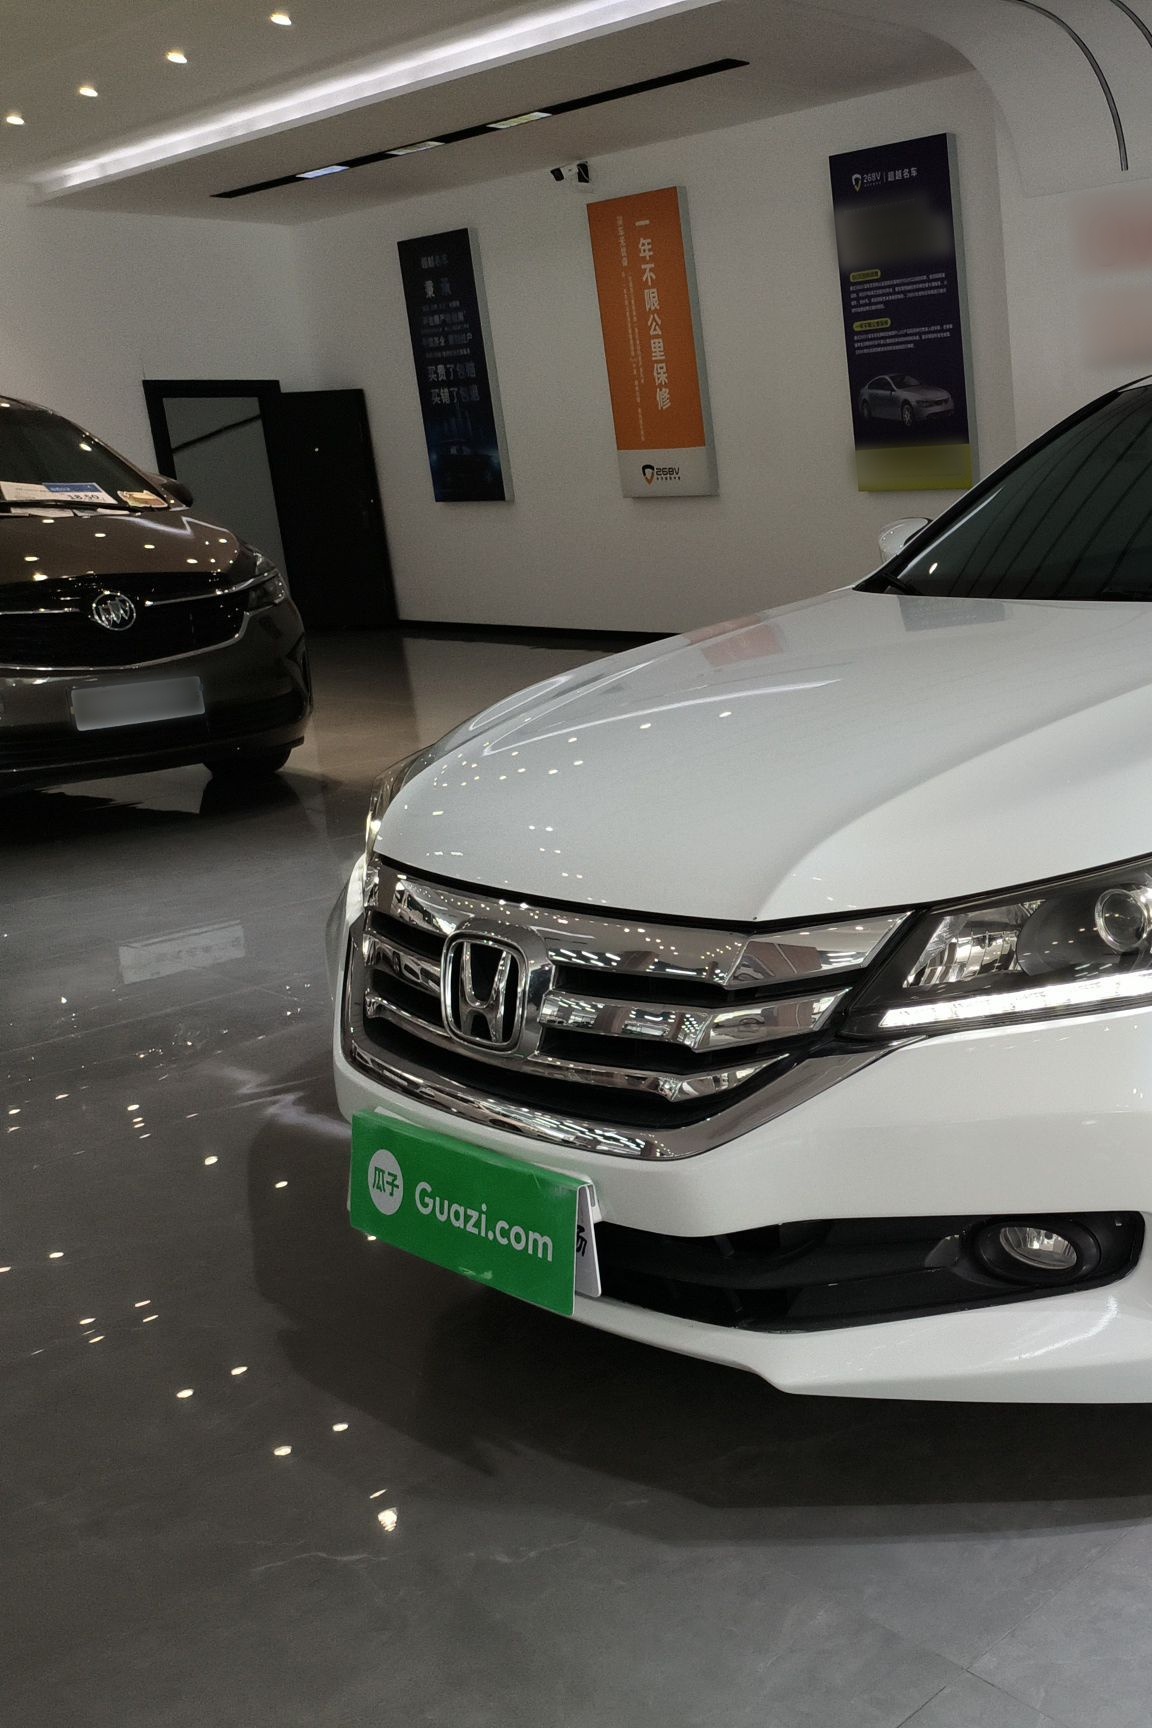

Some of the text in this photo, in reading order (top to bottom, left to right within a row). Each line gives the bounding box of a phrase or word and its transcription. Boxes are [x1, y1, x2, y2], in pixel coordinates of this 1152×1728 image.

[862, 171, 881, 183] 268V
[635, 219, 672, 411] 一年不限公里保修
[655, 467, 680, 476] 268V
[372, 1166, 400, 1197] 瓜子
[415, 1181, 553, 1262] Guazi.com
